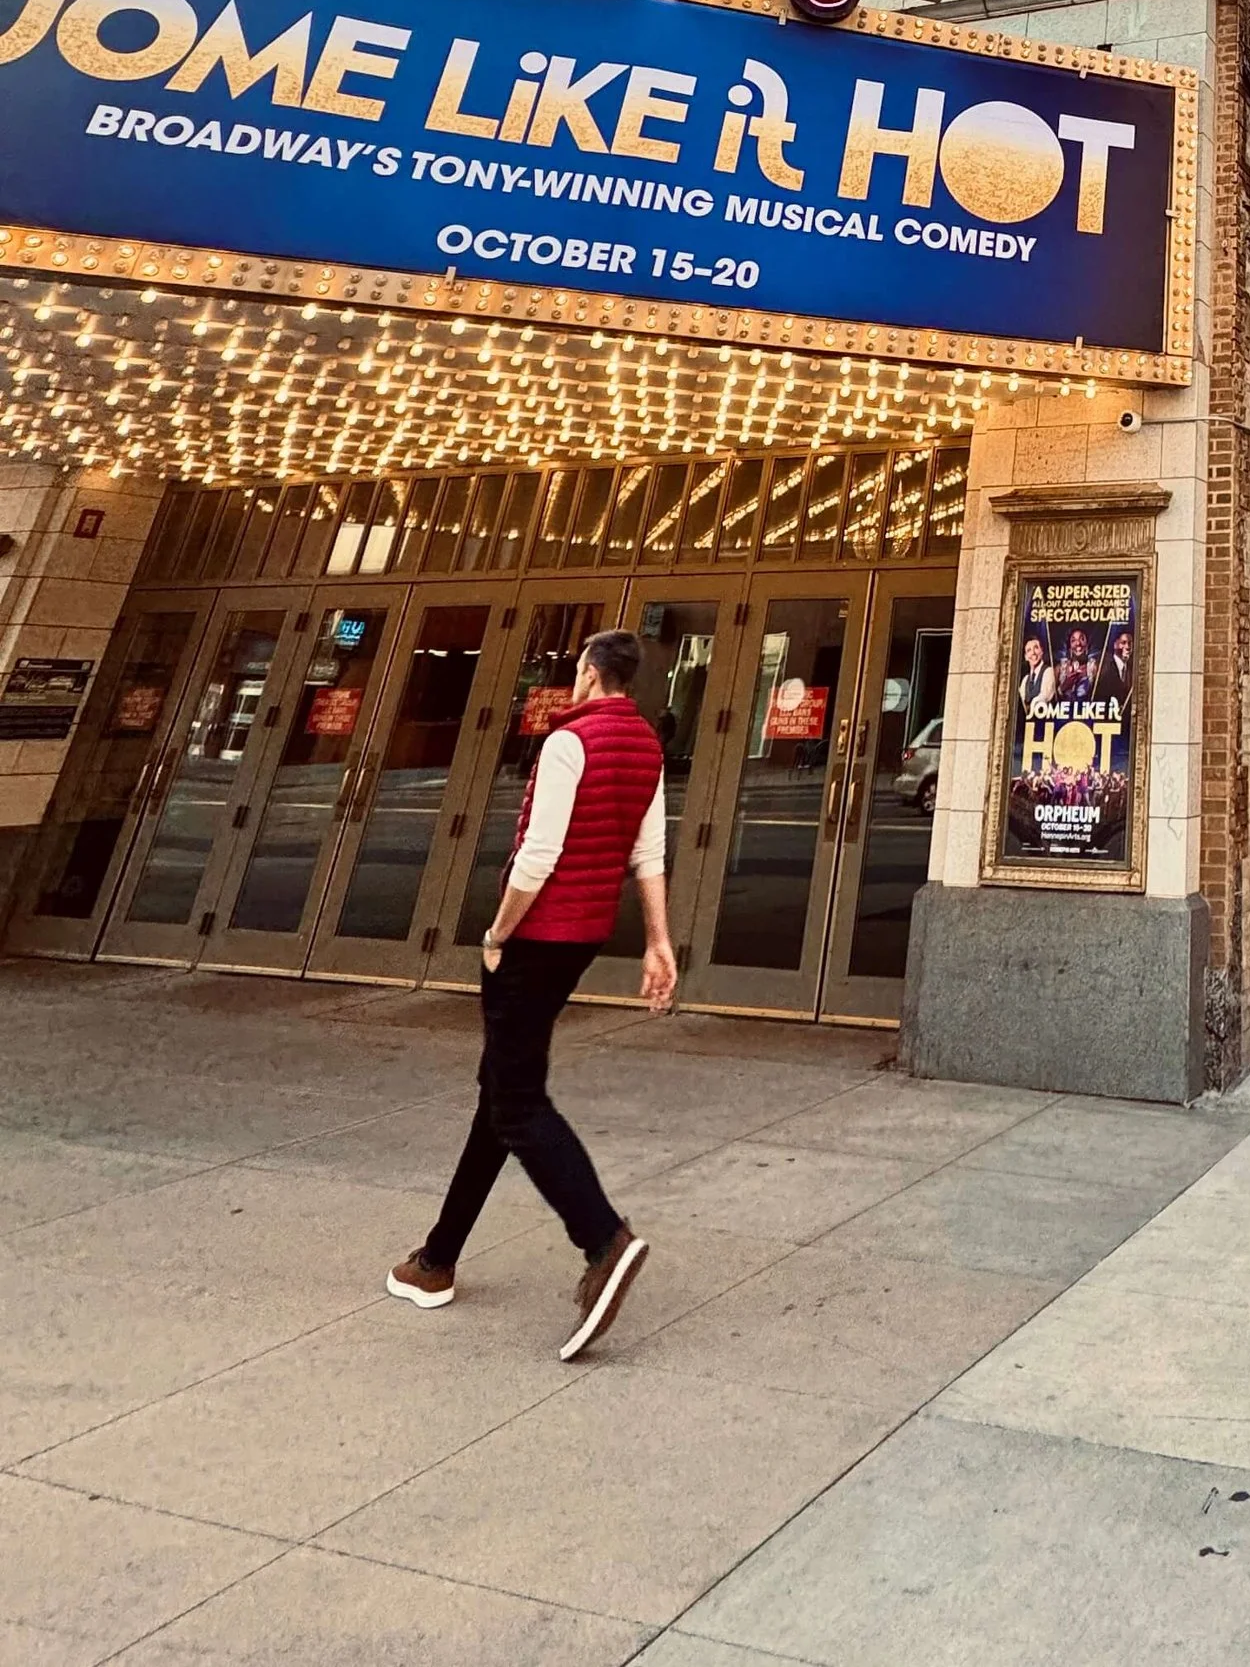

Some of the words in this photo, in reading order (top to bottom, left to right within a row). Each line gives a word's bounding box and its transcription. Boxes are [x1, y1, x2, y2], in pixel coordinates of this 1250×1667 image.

[837, 79, 1135, 234] HOT
[86, 105, 401, 175] BROADWAY'S
[411, 151, 714, 216] TONY-WINNING
[724, 196, 883, 242] MUSICAL
[895, 218, 1037, 262] COMEDY
[436, 225, 636, 276] OCTOBER
[650, 248, 759, 288] 15-20
[1032, 586, 1043, 599] A
[1032, 600, 1060, 608] ALL-OUT
[1062, 599, 1129, 607] SONG-AND-DANCE
[1030, 608, 1131, 622] SPECTACULAR!
[1026, 696, 1070, 720] SOME
[1022, 721, 1121, 774] HOT
[1034, 805, 1100, 823] ORPHEUM
[1041, 823, 1072, 831] OCTOBER
